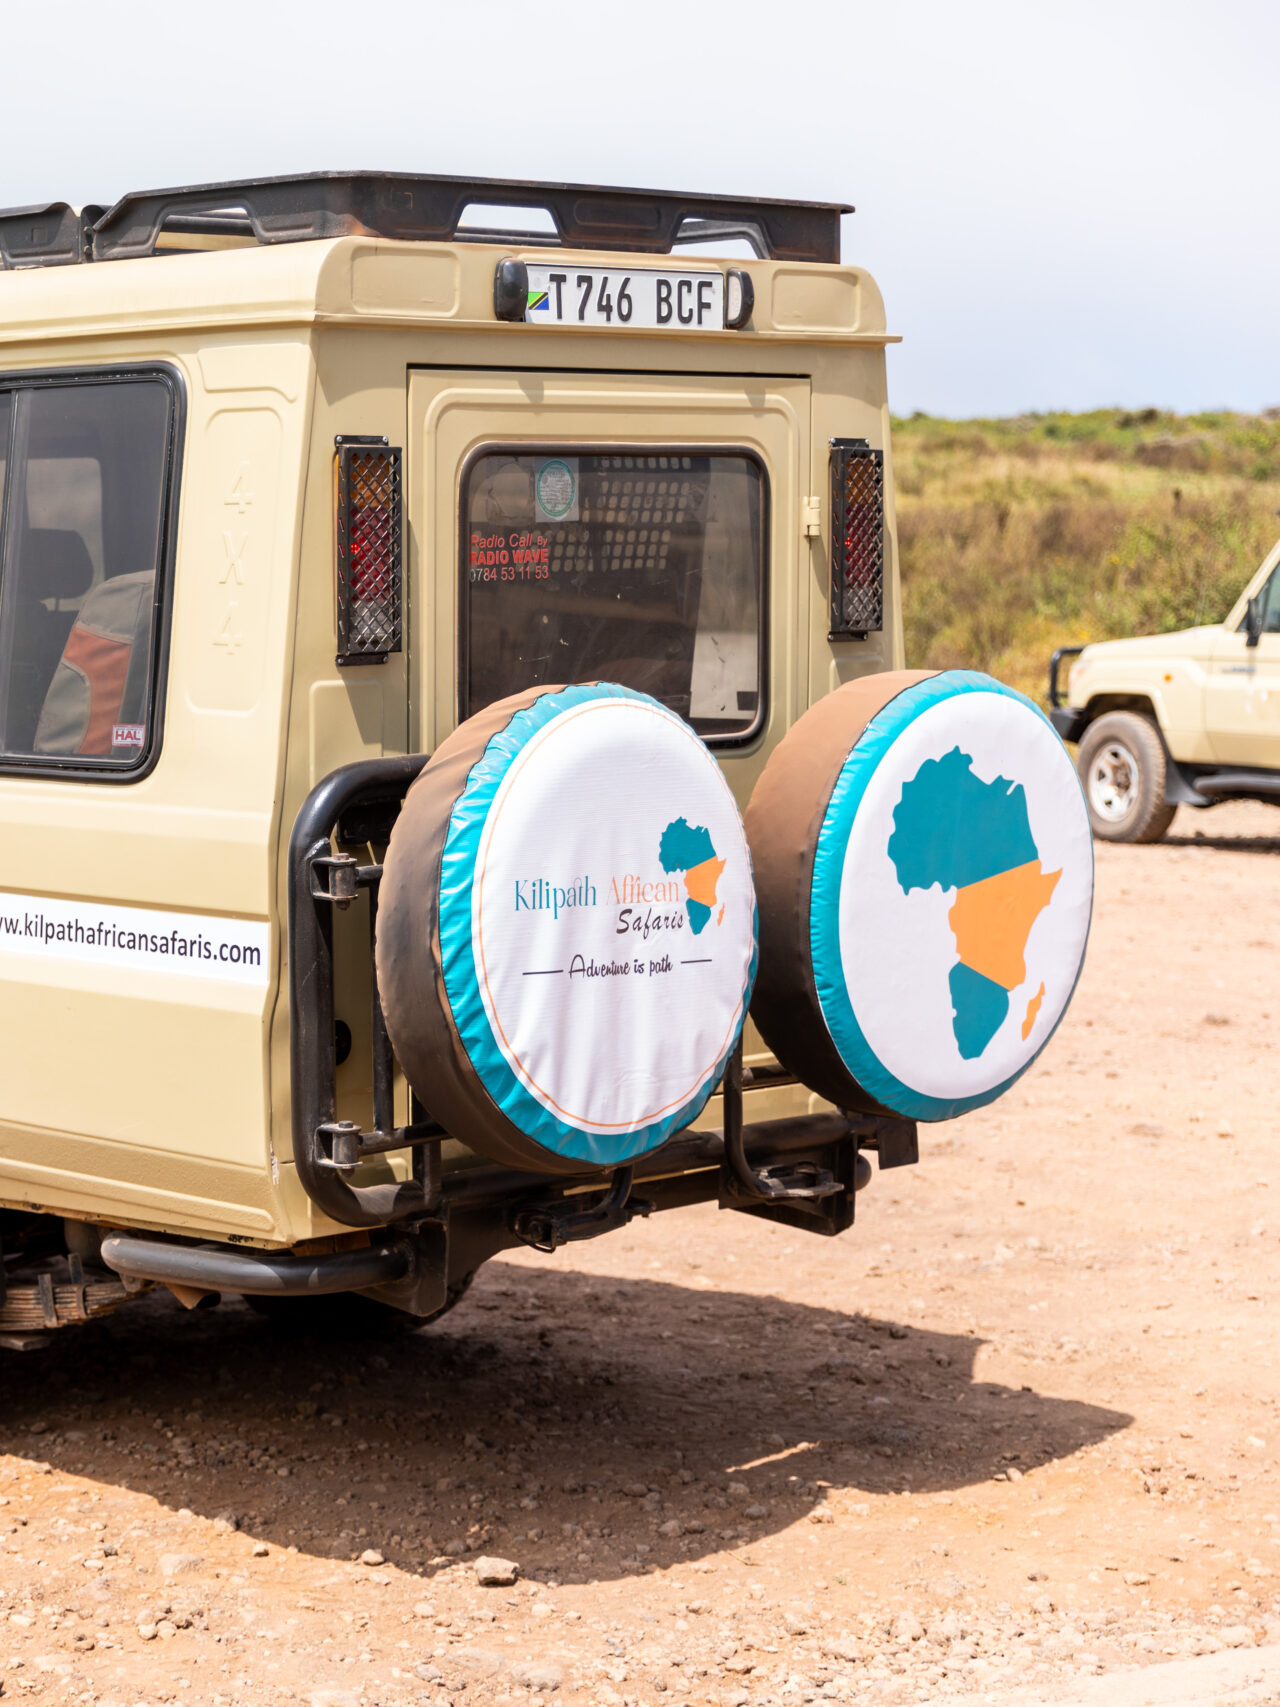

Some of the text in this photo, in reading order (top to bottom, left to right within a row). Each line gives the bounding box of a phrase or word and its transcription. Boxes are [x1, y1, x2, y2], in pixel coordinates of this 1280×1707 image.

[656, 278, 713, 325] BCF
[470, 533, 548, 548] Radio Call By
[470, 548, 549, 565] RADIO WAVE
[501, 566, 515, 581] 53
[520, 566, 530, 580] 11
[535, 565, 549, 579] 53
[115, 730, 141, 741] HAL
[515, 874, 680, 920] Kilipath African
[616, 908, 684, 940] Safaris
[568, 954, 673, 979] Adventure is path
